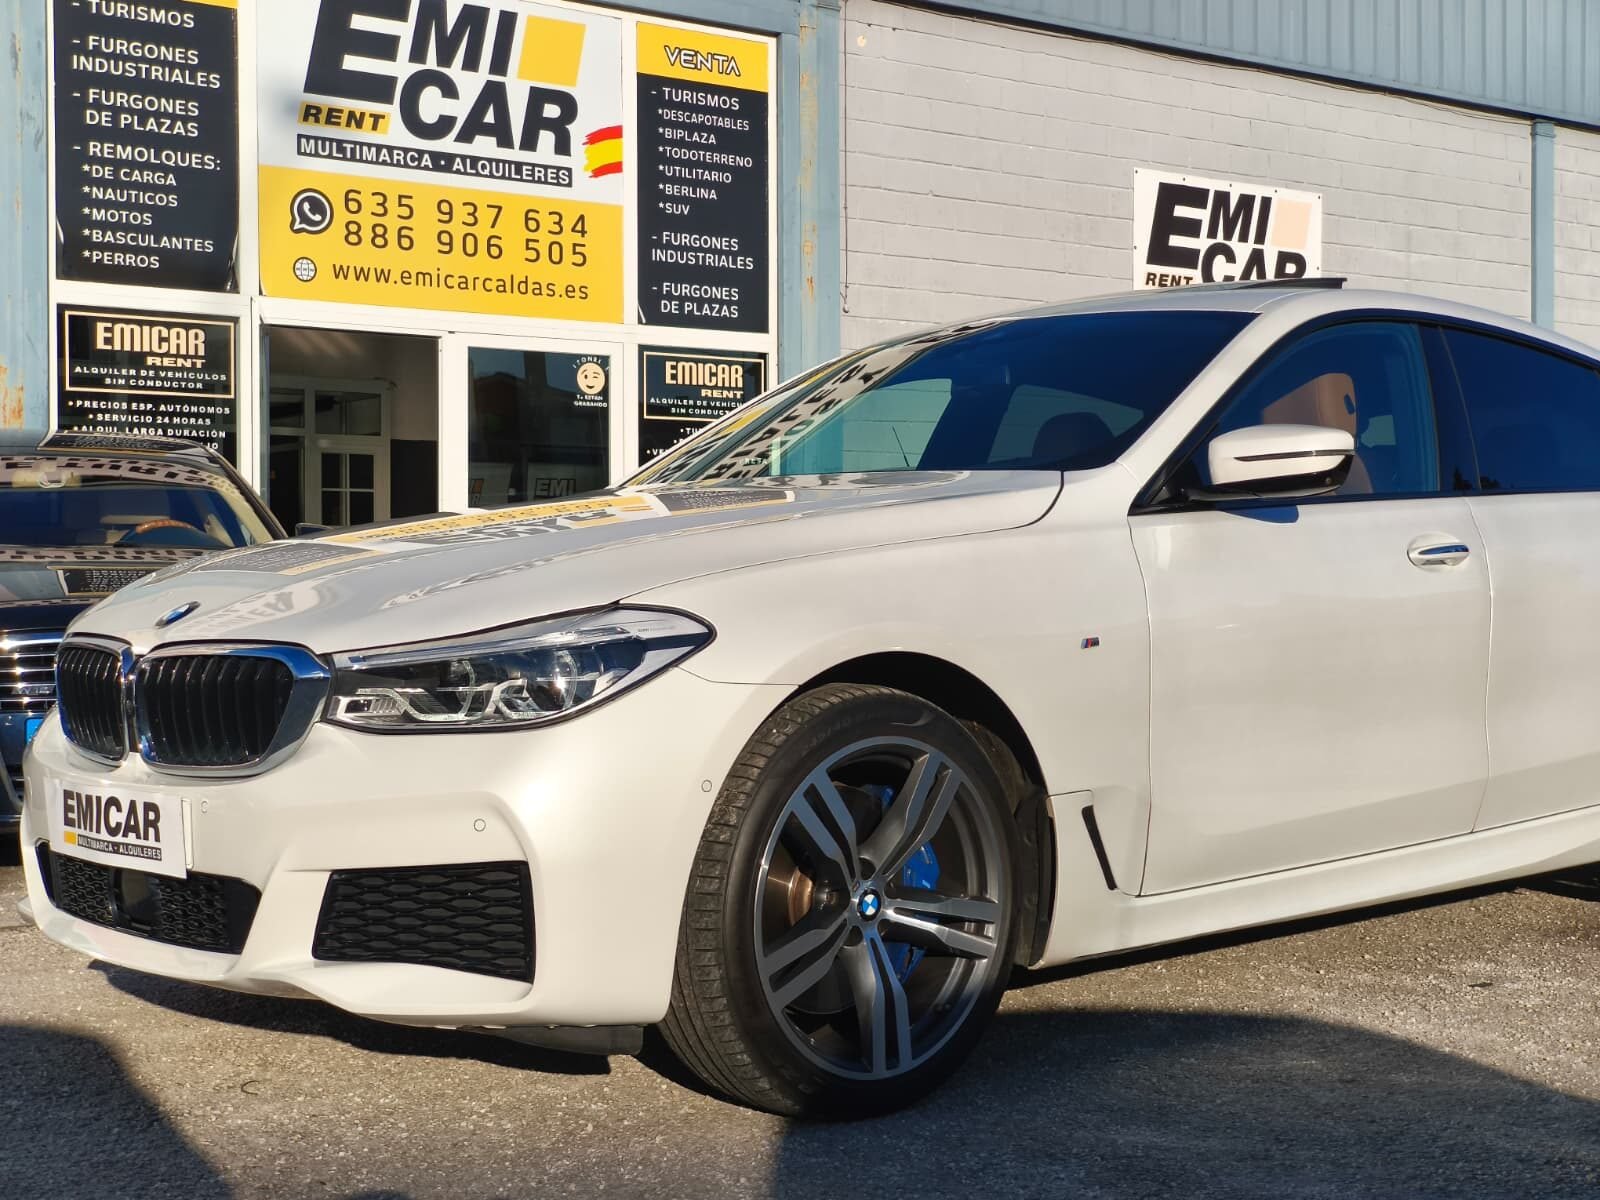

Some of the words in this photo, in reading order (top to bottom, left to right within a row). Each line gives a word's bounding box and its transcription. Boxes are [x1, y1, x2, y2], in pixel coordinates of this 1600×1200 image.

[90, 0, 195, 28] TURISMOS
[88, 35, 199, 64] FURGONES
[664, 45, 741, 77] VENTA
[73, 54, 221, 89] INDUSTRIALES
[88, 88, 199, 116] FURGONES
[662, 87, 740, 110] TURISMOS
[86, 109, 112, 127] DE
[120, 114, 199, 137] PLAZAS
[302, 104, 386, 131] RENT
[399, 68, 579, 157] CAR
[89, 141, 222, 171] REMOLQUES:
[300, 137, 434, 169] MULTIMARCA
[452, 158, 570, 185] ALQUILERES
[120, 169, 177, 186] CARGA
[344, 189, 415, 220] 635
[436, 199, 503, 229] 937
[524, 209, 588, 238] 634
[1146, 182, 1273, 270] EMI
[344, 221, 415, 251] 886
[436, 230, 503, 259] 906
[524, 239, 588, 267] 505
[662, 231, 739, 251] FURGONES
[651, 248, 754, 270] INDUSTRIALES
[333, 263, 589, 300] www.emicarcaldas.es
[663, 282, 739, 301] FURGONES
[1145, 272, 1194, 288] RENT
[661, 300, 679, 314] DE
[684, 302, 739, 318] PLAZAS
[96, 321, 206, 356] EMICAR
[74, 366, 137, 376] ALQUILER
[140, 369, 155, 377] DE
[159, 371, 227, 381] VEHÍCULOS
[146, 356, 206, 368] RENT
[665, 360, 744, 388] EMICAR
[130, 379, 203, 389] CONDUCTOR
[701, 389, 744, 399] RENT
[76, 400, 128, 409] PRECIOS
[131, 403, 156, 411] ESP.
[159, 404, 230, 415] AUTÓNOMOS
[650, 397, 694, 406] ALQUILER
[96, 413, 153, 423] SERVICIO
[156, 416, 170, 424] 24
[173, 416, 211, 426] HORAS
[126, 426, 164, 436] LARGA
[167, 428, 226, 438] DURACIÓN
[63, 789, 161, 843] EMICAR
[79, 835, 114, 852] MULTIMARCA
[119, 844, 161, 859] ALQUILERES
